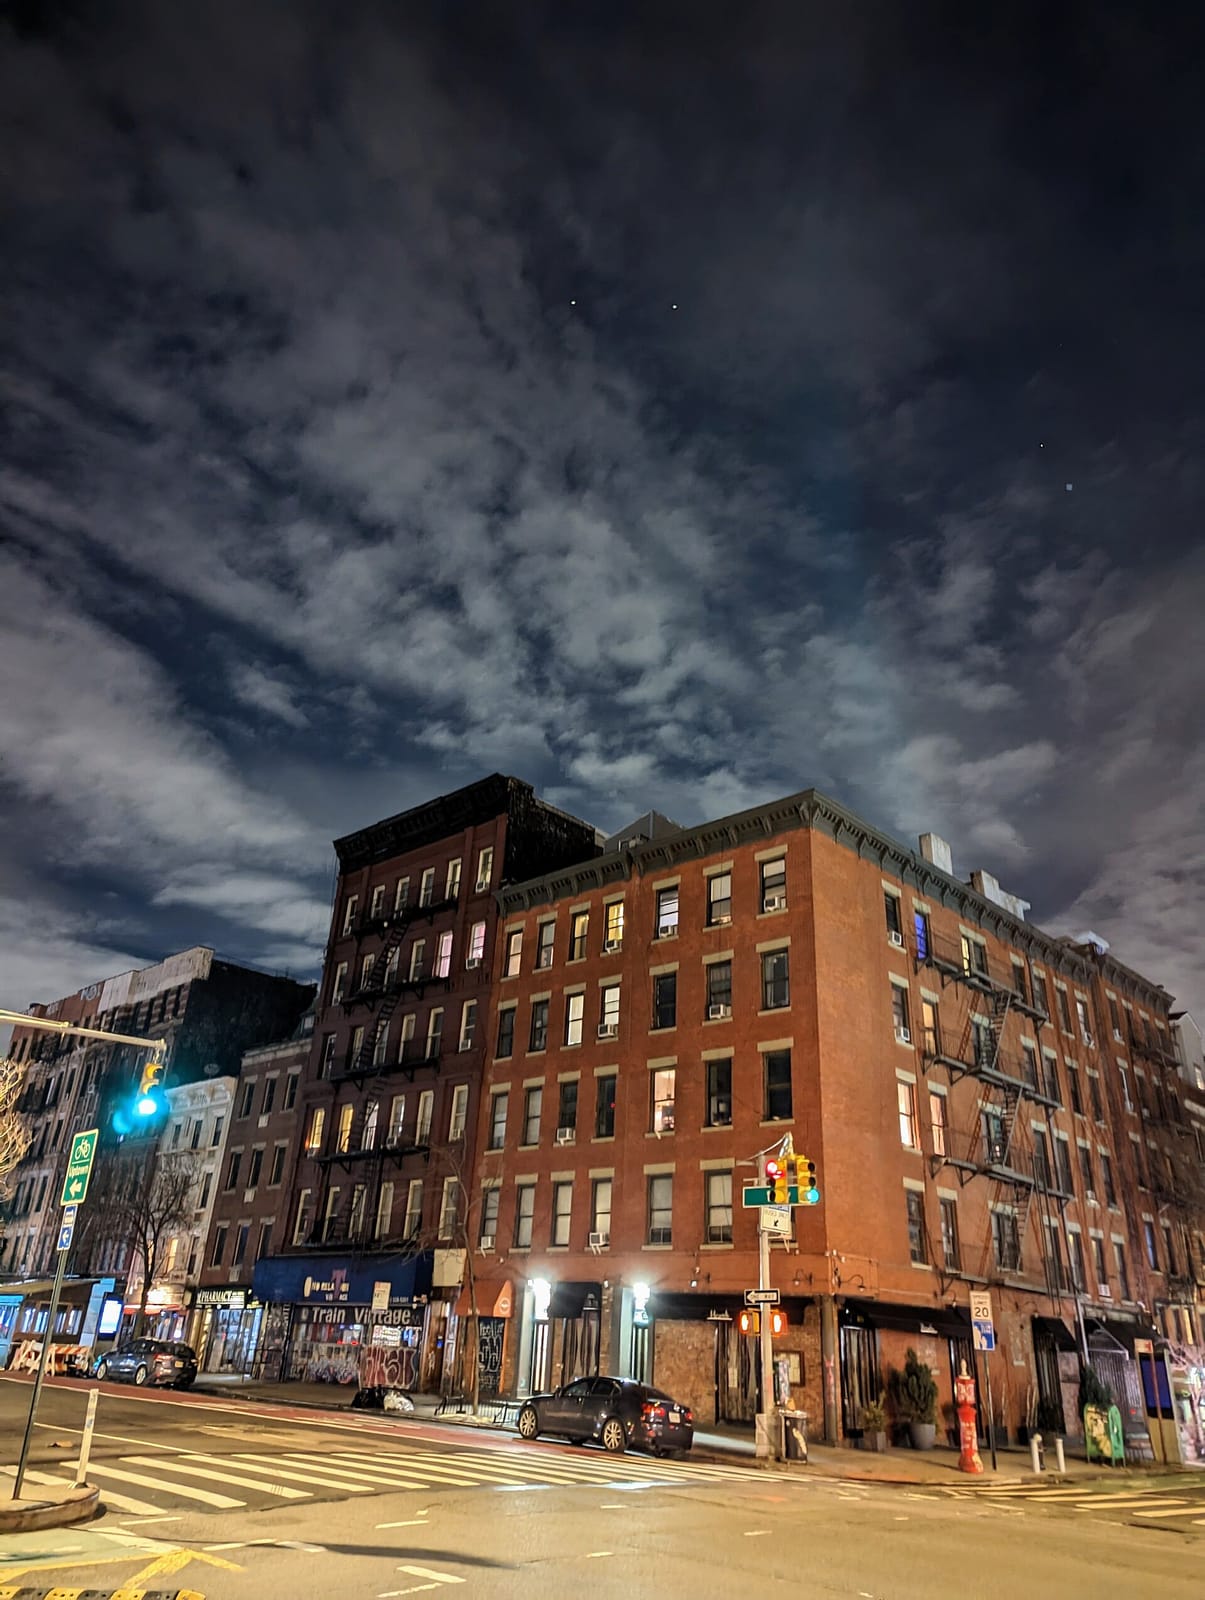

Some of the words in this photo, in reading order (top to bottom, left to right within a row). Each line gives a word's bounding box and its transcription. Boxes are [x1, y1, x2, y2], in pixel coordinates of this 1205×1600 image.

[69, 1165, 88, 1179] Uptown
[202, 1290, 232, 1303] PHARMACY
[312, 1308, 345, 1324] Train
[355, 1308, 411, 1325] Vintage
[974, 1307, 989, 1317] 20
